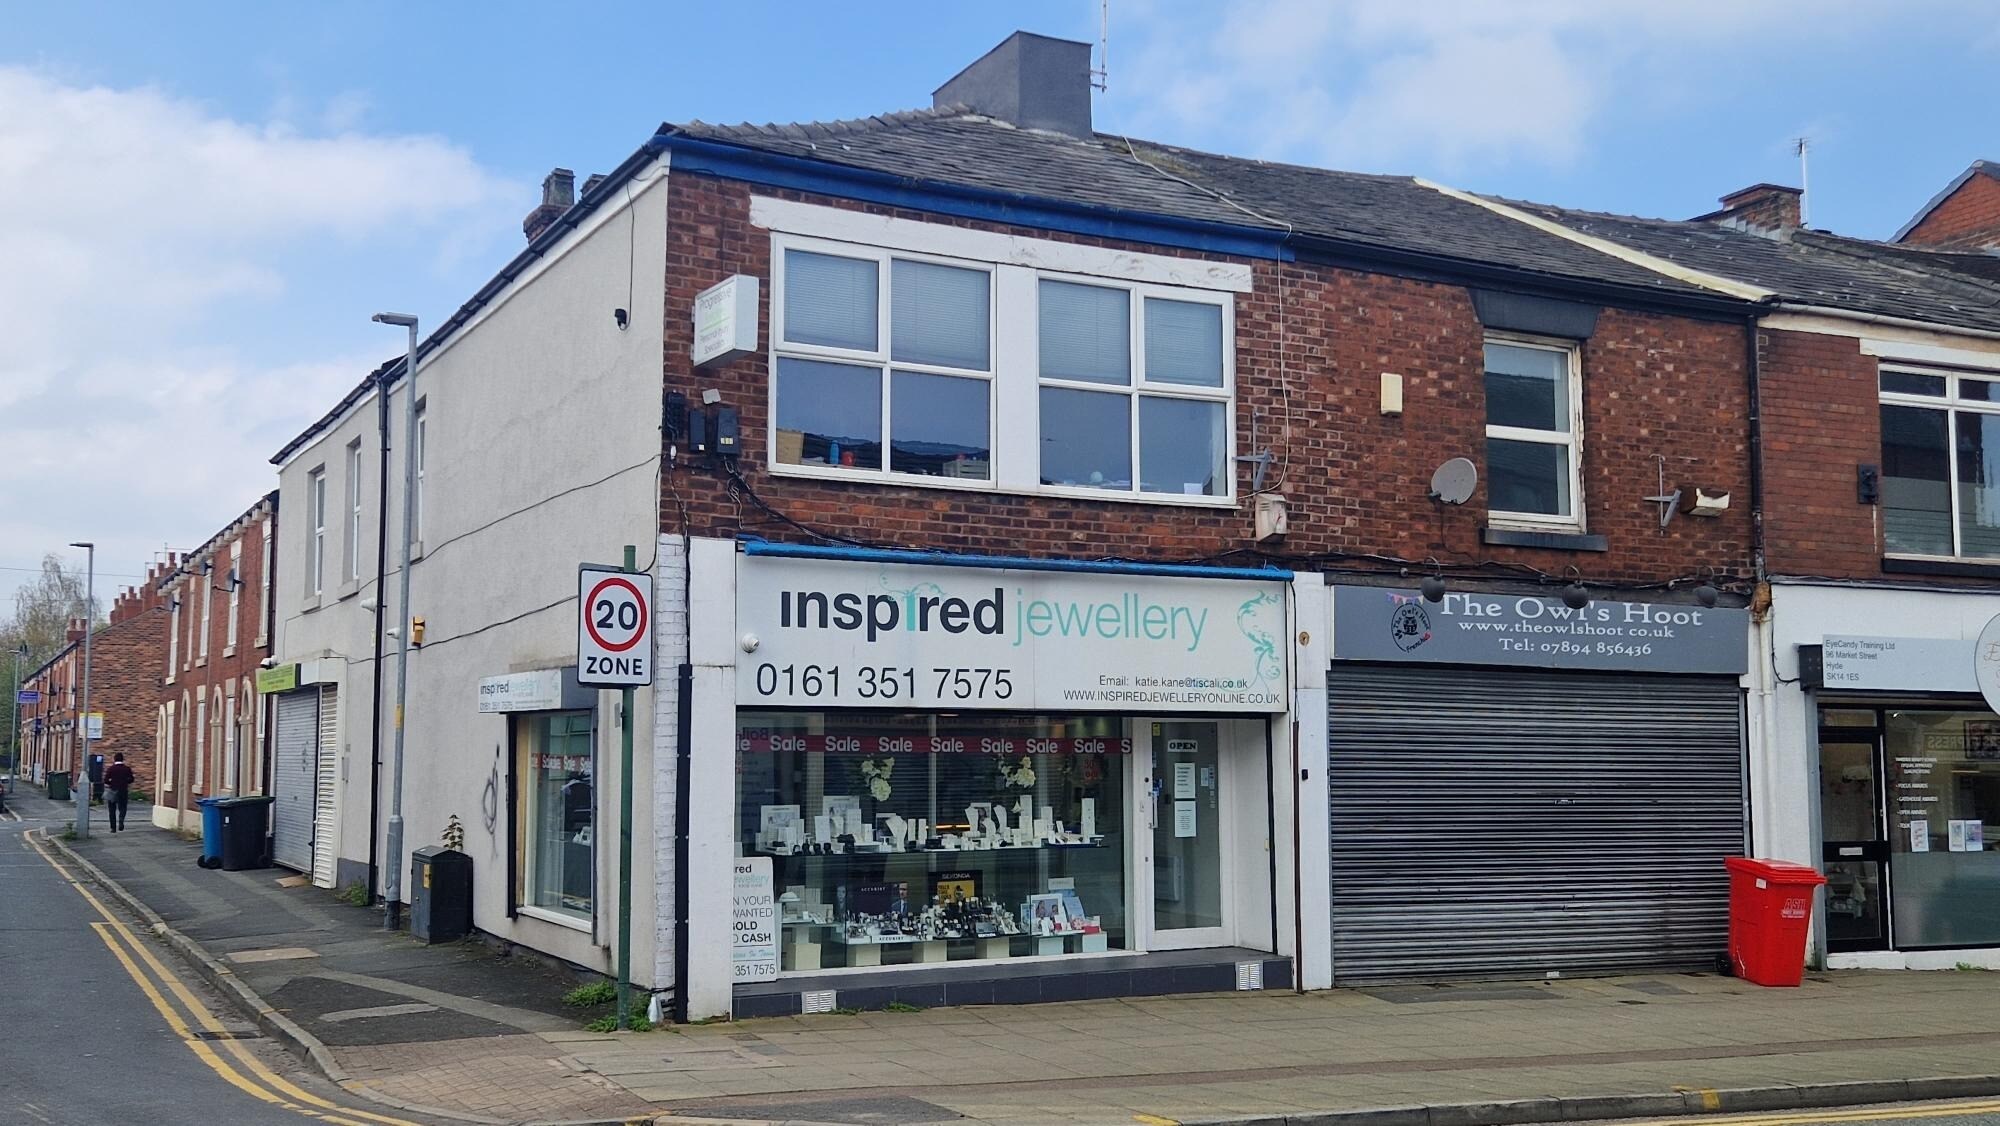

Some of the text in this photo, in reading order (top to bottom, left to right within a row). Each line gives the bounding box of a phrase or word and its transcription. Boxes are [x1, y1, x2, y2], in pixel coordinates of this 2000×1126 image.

[596, 600, 638, 630] 20
[1441, 594, 1703, 626] The Owl's Hoot
[781, 587, 1208, 651] inspired jewellery
[1498, 638, 1652, 656] Tel: 07894 856436
[1825, 640, 1858, 649] EyeCandy
[1859, 641, 1884, 651] Training
[586, 656, 643, 676] ZONE
[1826, 662, 1843, 671] Hyde
[756, 663, 1012, 699] 0161 351 7575
[1099, 675, 1129, 686] Email:
[1826, 672, 1844, 680] SK14
[1063, 690, 1280, 704] WWW.INSPIREDJEWELLERYONLINE.CO.UK
[770, 735, 806, 751] Sale
[825, 736, 861, 752] Sale
[878, 737, 913, 752] Sale
[930, 737, 964, 753] Sale
[981, 738, 1014, 753] Sale
[1026, 738, 1058, 753] Sale
[1074, 739, 1105, 753] Sale
[1169, 742, 1197, 750] OPEN
[743, 896, 771, 905] YOUR
[733, 921, 758, 931] OLD
[741, 933, 771, 943] CASH
[735, 964, 775, 976] 351 7575
